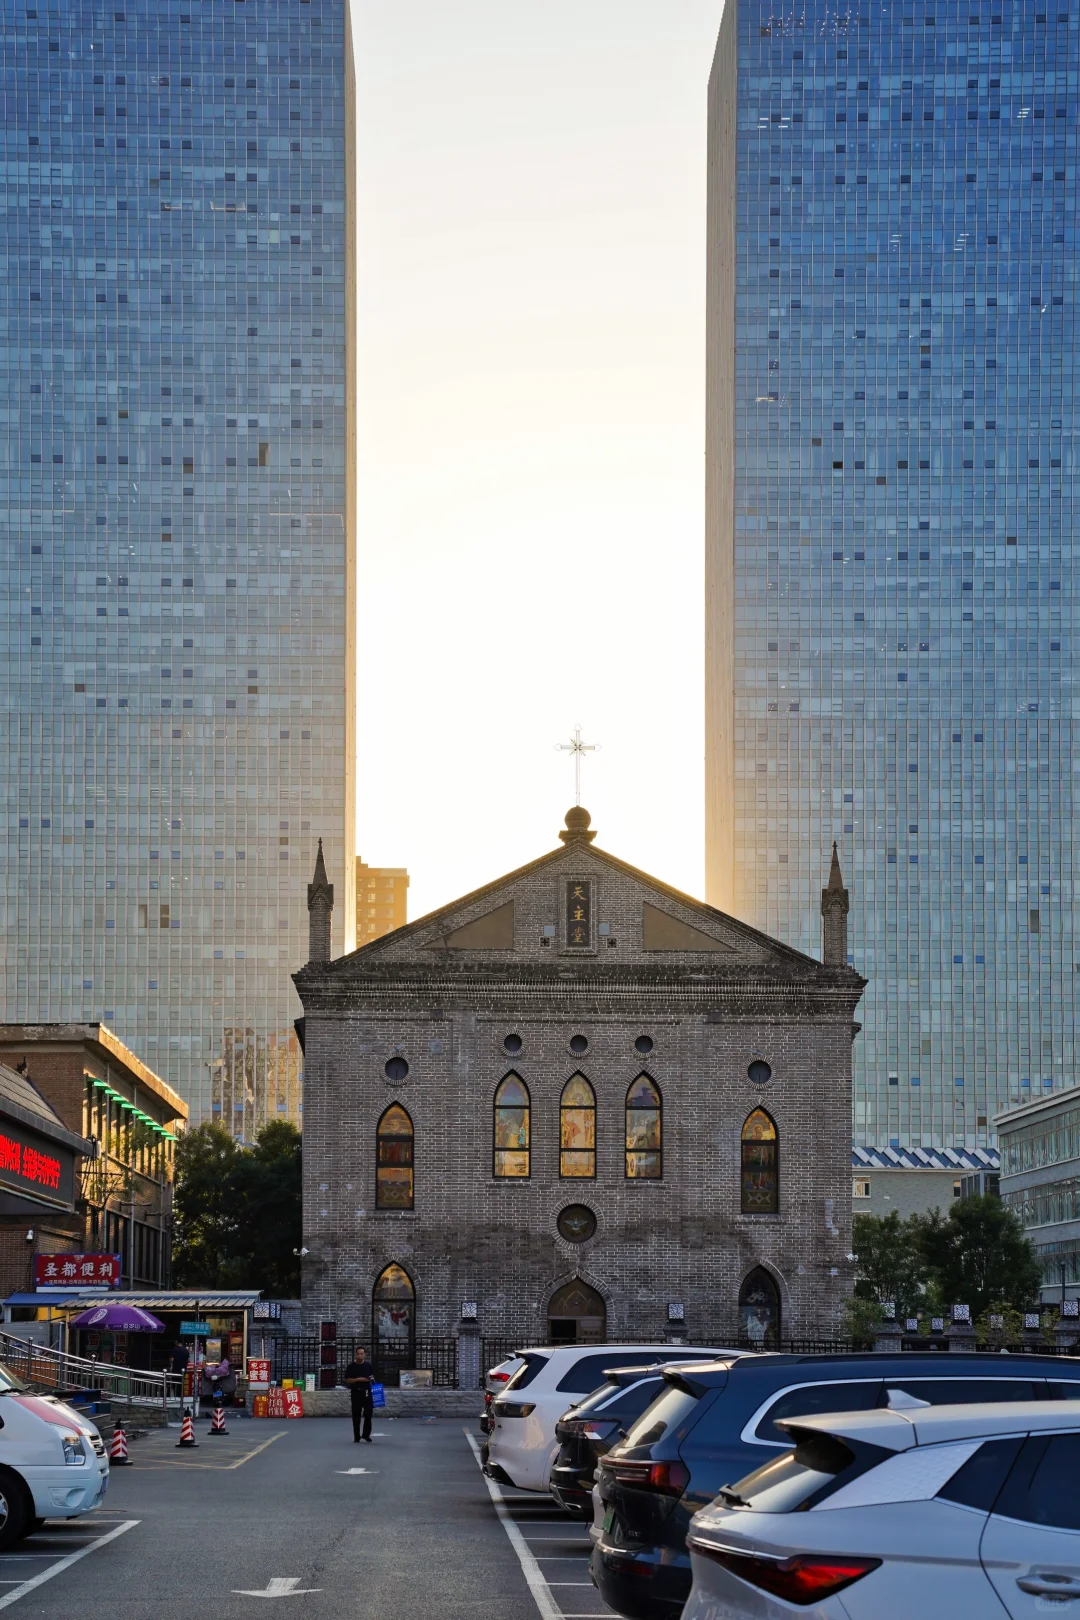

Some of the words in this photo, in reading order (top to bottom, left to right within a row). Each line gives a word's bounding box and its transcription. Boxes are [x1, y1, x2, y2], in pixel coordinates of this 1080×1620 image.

[570, 886, 587, 943] 天主堂
[44, 1262, 113, 1277] 圣都便利
[285, 1390, 301, 1416] 雨伞
